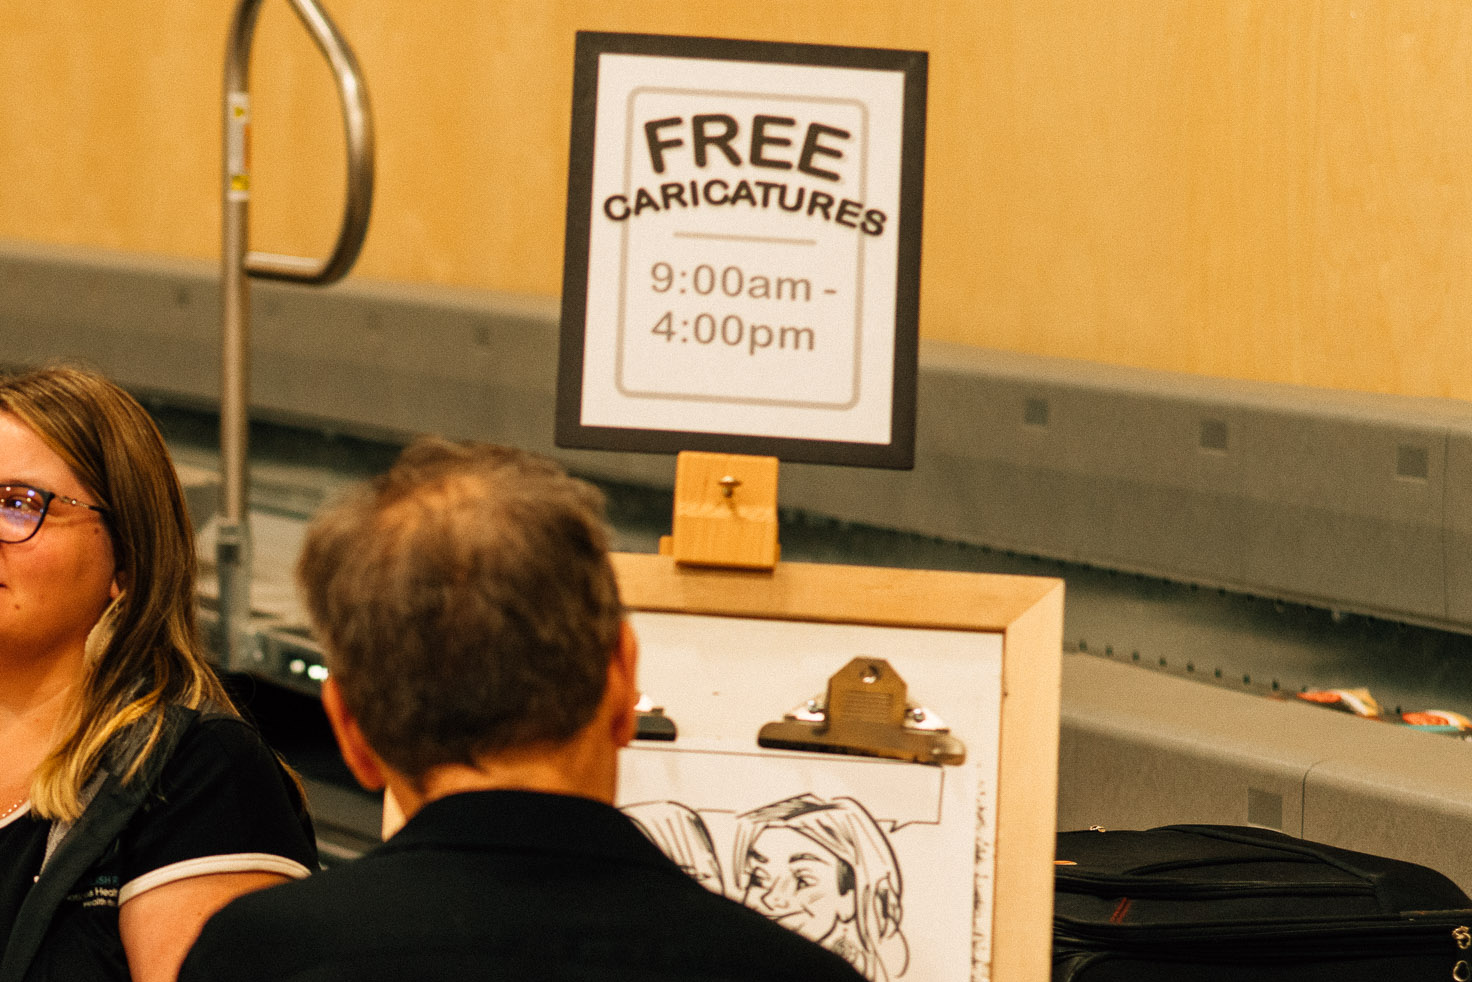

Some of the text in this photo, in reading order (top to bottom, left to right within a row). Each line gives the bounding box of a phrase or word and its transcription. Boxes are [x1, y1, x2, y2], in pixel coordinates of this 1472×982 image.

[644, 114, 852, 182] FREE
[603, 179, 888, 237] CARICATURES
[650, 261, 812, 302] 9:00am
[650, 311, 815, 356] 4:00pm
